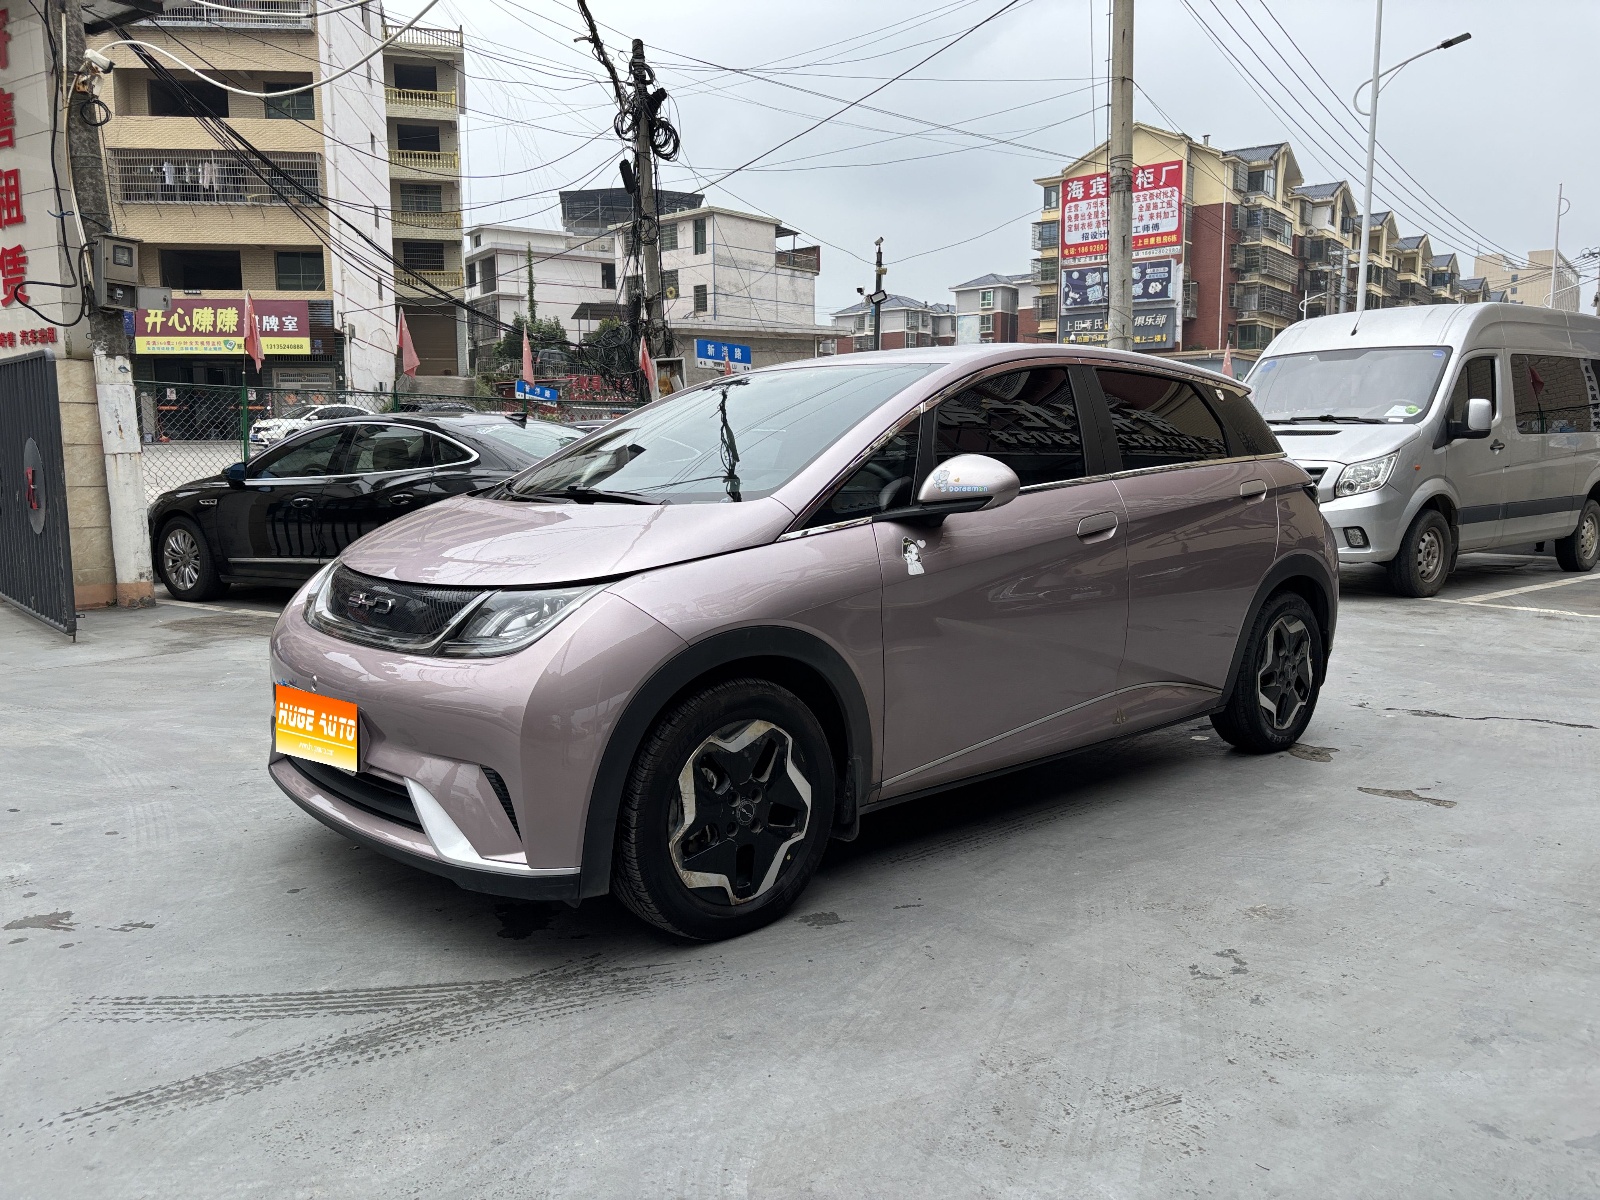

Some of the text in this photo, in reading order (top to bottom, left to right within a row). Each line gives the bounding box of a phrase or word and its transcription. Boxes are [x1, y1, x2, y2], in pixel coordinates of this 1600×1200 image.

[1067, 165, 1179, 200] 海宾柜厂
[144, 307, 239, 333] 开心赚赚
